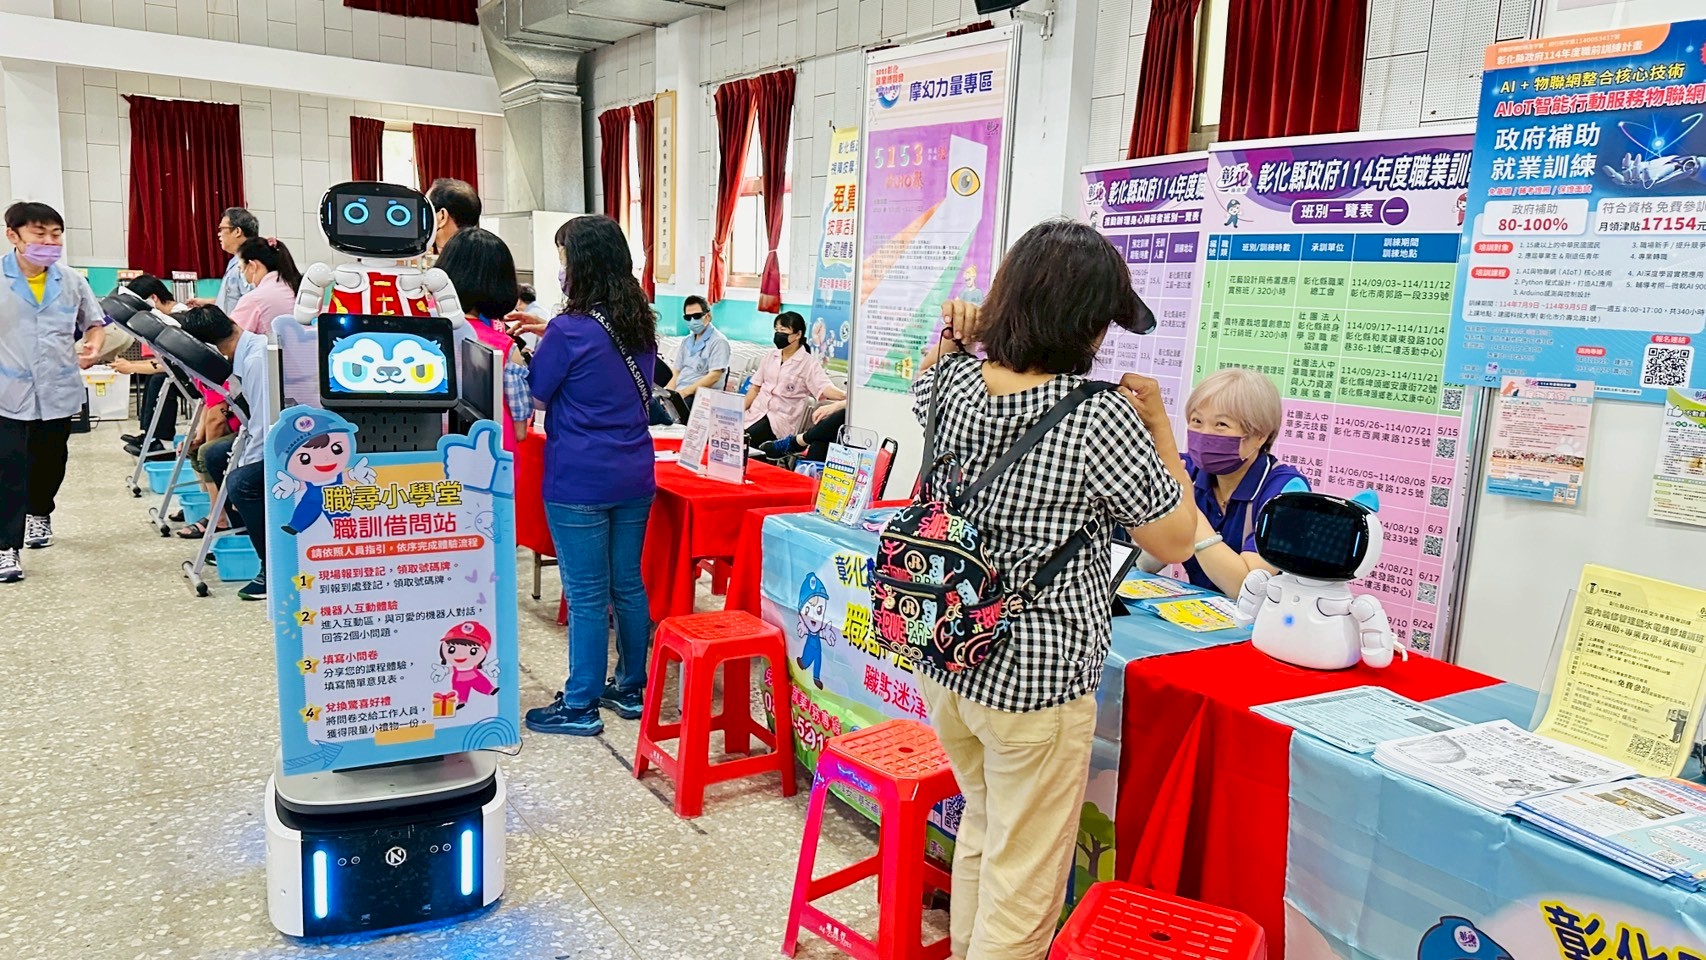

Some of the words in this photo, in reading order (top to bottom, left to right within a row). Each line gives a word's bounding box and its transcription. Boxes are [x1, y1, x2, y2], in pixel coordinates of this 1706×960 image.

[1500, 80, 1516, 93] AI
[1534, 63, 1686, 92] 物聯網整合核心技術
[909, 70, 994, 102] 摩幻力量專區
[1495, 122, 1601, 151] 政府補助
[1257, 152, 1472, 194] 彰化縣政府114年度職業訓
[1491, 154, 1597, 181] 就業訓練
[1300, 203, 1374, 219] 班別一覽表
[1512, 203, 1558, 215] 政府補助
[1602, 201, 1653, 214] 符合資格
[1656, 200, 1706, 214] 免費參訓
[1498, 217, 1568, 231] 80-100%
[1598, 216, 1706, 232] 月領津貼17154元
[1351, 278, 1450, 290] 114/09/03~114/11/12
[1521, 279, 1543, 287] Python
[1347, 321, 1445, 334] 114/09/17~114/11/14
[1341, 366, 1438, 382] 114/09/23~114/11/21
[1335, 417, 1432, 436] 114/05/26~114/07/21
[1437, 427, 1458, 437] 5/15
[1329, 465, 1426, 487] 114/06/05~114/08/08
[1431, 475, 1453, 486] 5/27
[323, 481, 463, 512] 職尋小學堂
[333, 512, 457, 539] 職訓借問站
[1427, 524, 1443, 534] 6/3
[300, 575, 307, 586] 1
[1173, 570, 1179, 578] 8
[1418, 571, 1440, 583] 6/17
[320, 600, 399, 617] 機器人互動體驗
[301, 611, 310, 622] 2
[1412, 618, 1434, 630] 6/24
[304, 659, 312, 670] 3
[322, 650, 379, 665] 填寫小問卷
[1617, 679, 1651, 695] 免費參訓
[325, 696, 392, 713] 兌換驚喜好禮
[305, 708, 315, 718] 4
